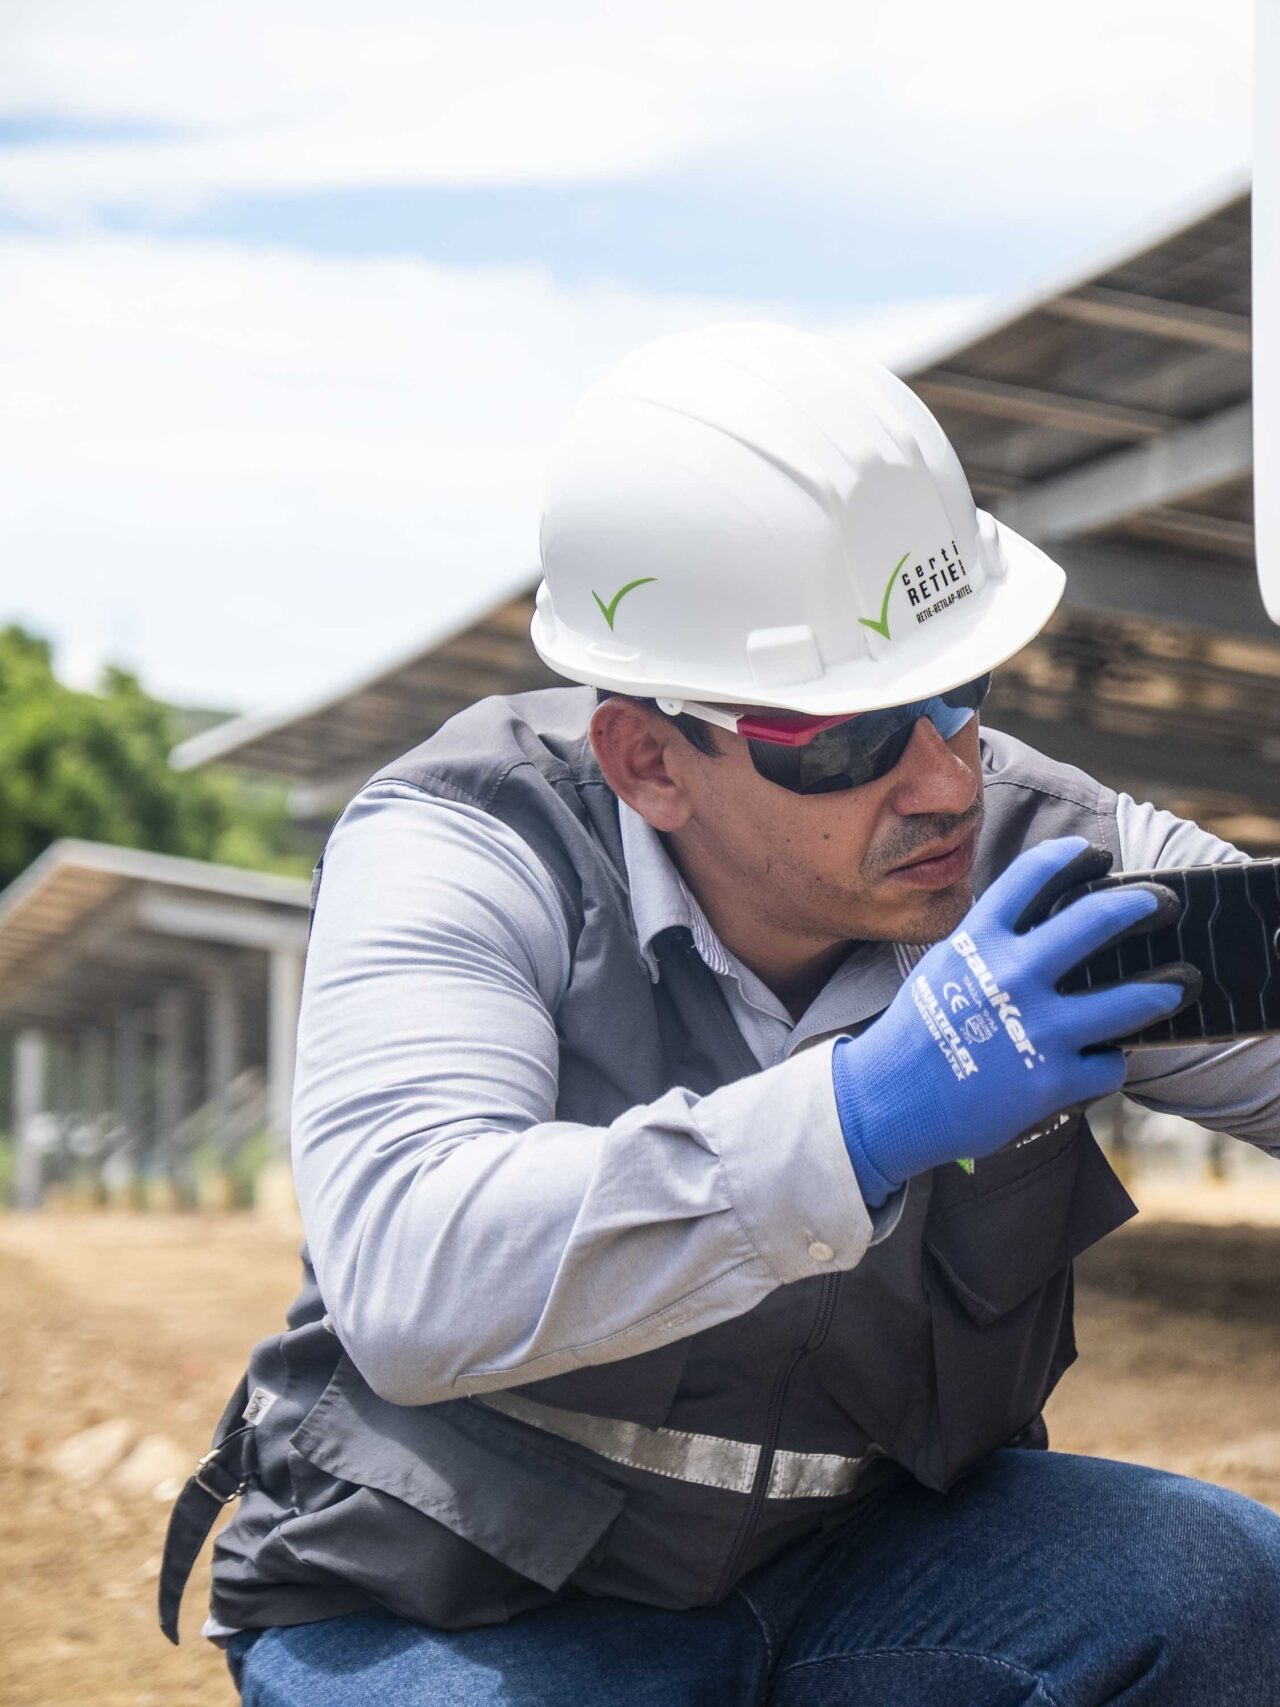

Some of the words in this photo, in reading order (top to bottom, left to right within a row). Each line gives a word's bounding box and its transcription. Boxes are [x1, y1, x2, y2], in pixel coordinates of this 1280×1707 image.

[901, 540, 959, 586] certi
[907, 563, 960, 606] RETIE
[915, 974, 979, 1077] MULTIFLEX
